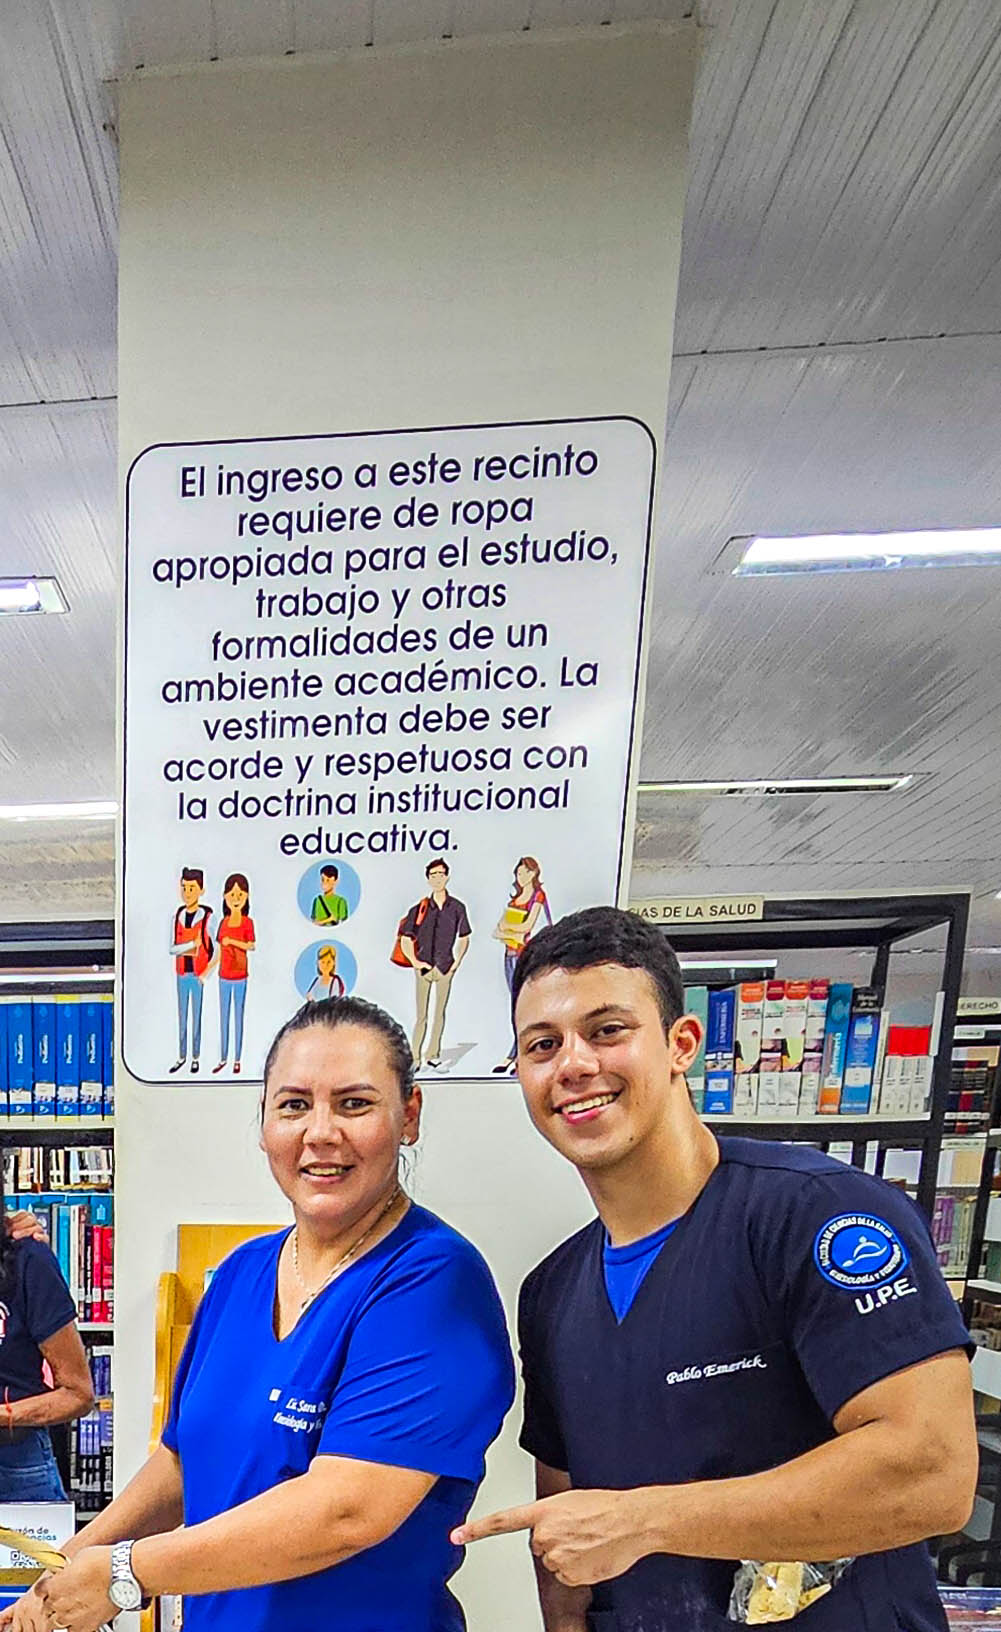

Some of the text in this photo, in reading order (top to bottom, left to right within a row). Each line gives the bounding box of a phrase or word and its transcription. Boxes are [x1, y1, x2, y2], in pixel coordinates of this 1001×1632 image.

[182, 445, 597, 501] El ingreso a este recinto
[239, 497, 533, 541] requiere de ropa
[153, 530, 617, 588] apropiada para el estudio,
[256, 579, 505, 622] trabajo y otras
[212, 620, 547, 662] formalidades de un
[162, 657, 598, 703] ambiente académico. La
[204, 703, 551, 740] vestimenta debe ser
[164, 744, 587, 784] acorde y respetuosa con
[179, 781, 569, 819] la doctrina institucional
[280, 824, 457, 855] educativa.
[663, 906, 681, 917] DE
[685, 906, 703, 917] LA
[709, 903, 757, 916] SALUD
[666, 1366, 702, 1385] Pablo
[36, 1526, 49, 1534] de
